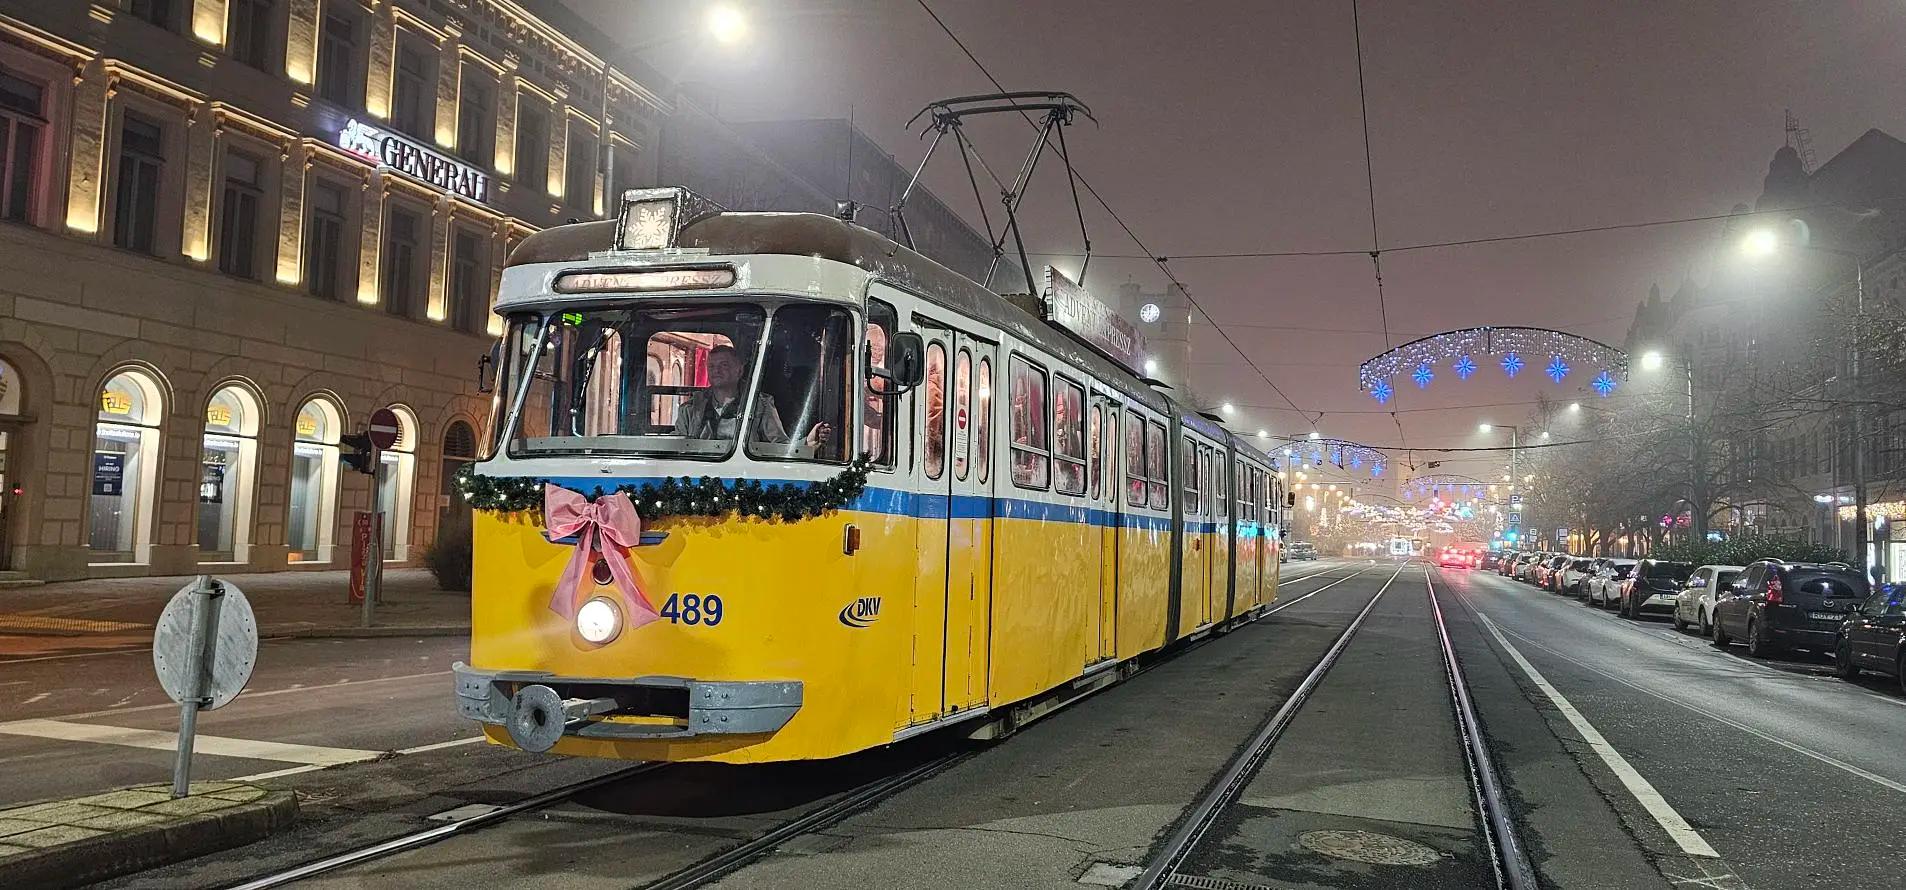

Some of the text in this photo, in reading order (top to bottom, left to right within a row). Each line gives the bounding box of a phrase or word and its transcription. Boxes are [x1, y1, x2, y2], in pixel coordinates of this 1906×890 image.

[380, 137, 489, 204] GENERALI
[574, 277, 631, 290] ADVEN
[660, 593, 723, 627] 489
[857, 597, 882, 617] DKV
